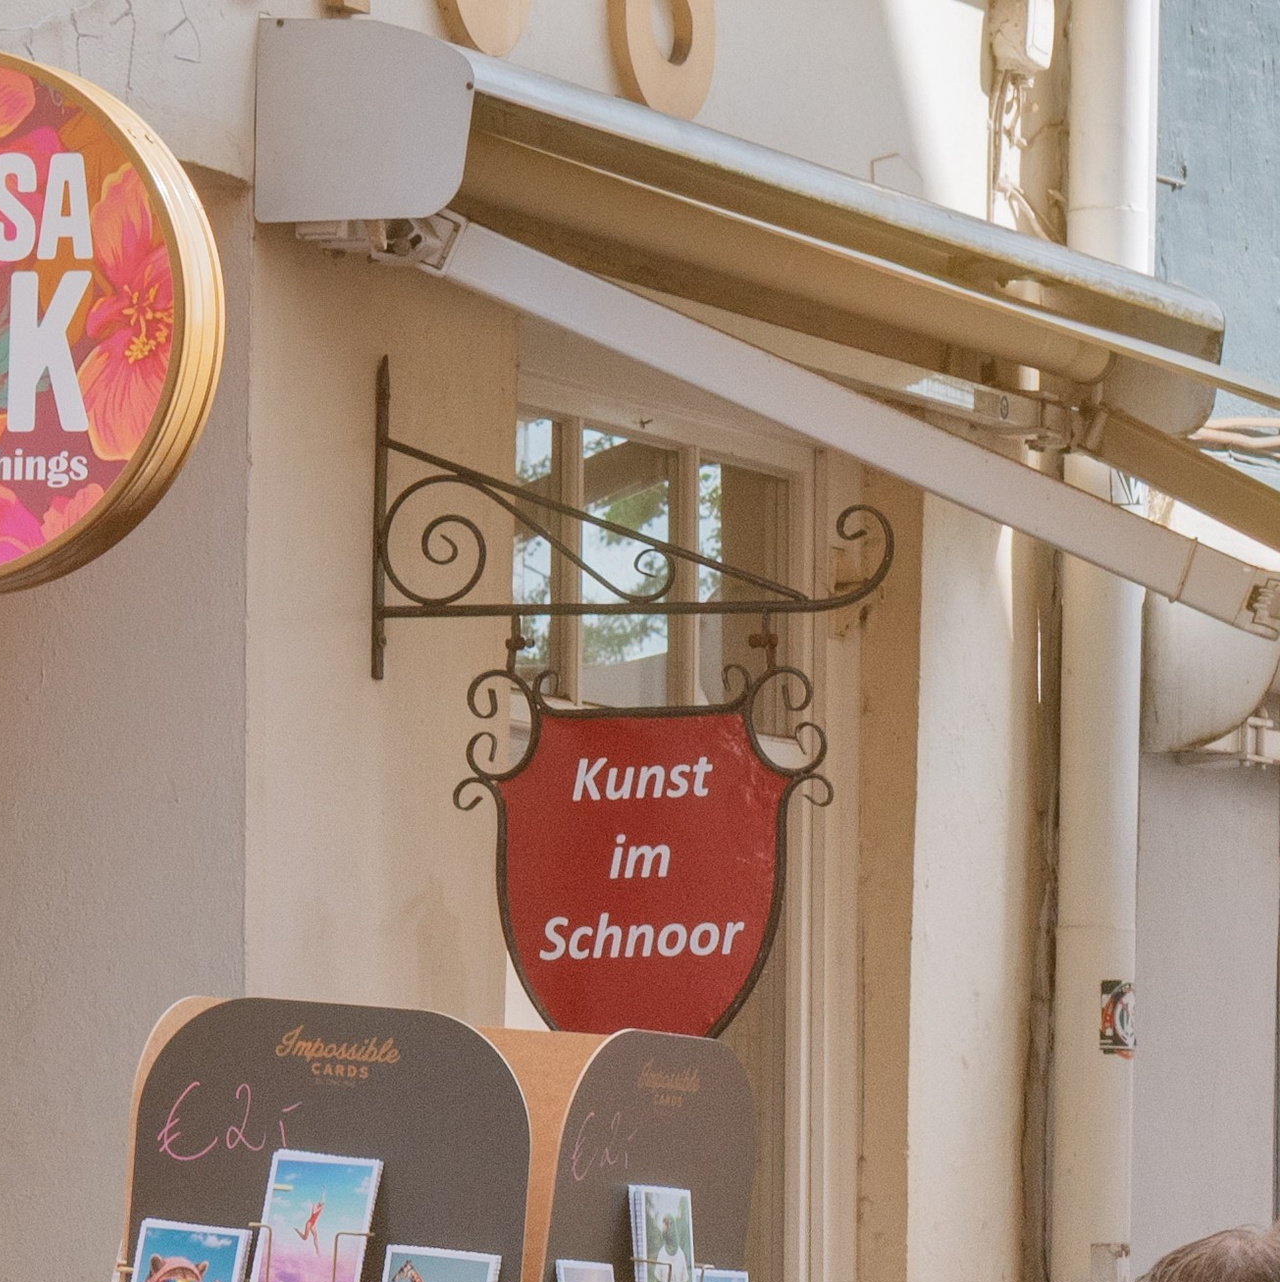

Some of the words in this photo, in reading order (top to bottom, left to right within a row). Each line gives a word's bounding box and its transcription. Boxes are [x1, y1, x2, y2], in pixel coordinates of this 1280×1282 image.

[572, 757, 713, 801] Kunst
[609, 833, 671, 879] im
[539, 912, 745, 960] Schnoor
[275, 1025, 400, 1063] Impossible
[311, 1062, 369, 1079] CARDS
